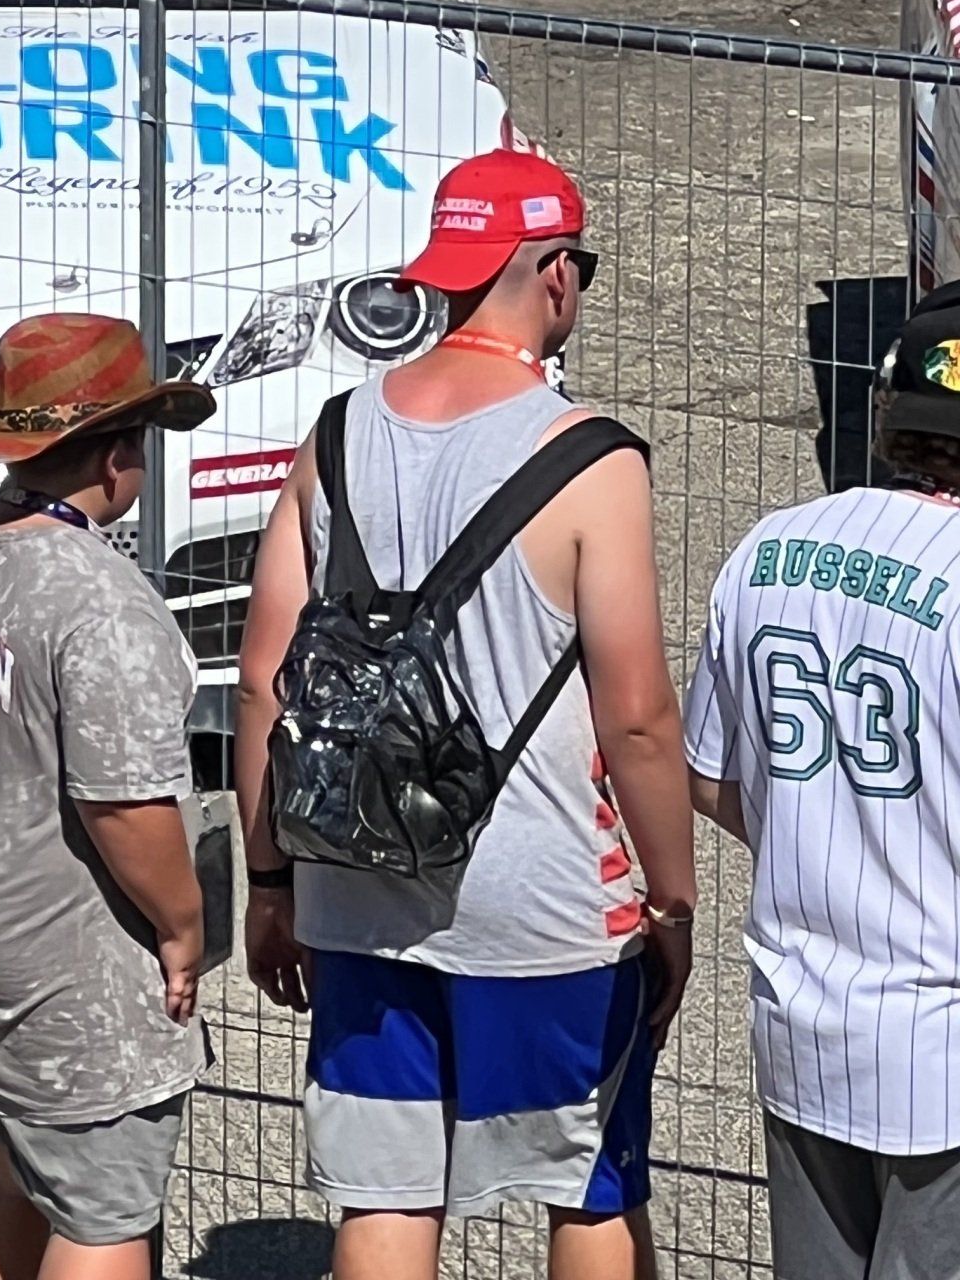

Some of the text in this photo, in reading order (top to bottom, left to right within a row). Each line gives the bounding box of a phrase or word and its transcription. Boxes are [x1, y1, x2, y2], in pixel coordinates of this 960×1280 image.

[91, 25, 260, 43] Finish
[214, 175, 337, 211] 1952
[749, 538, 949, 631] RUSSELL
[747, 624, 924, 800] 63
